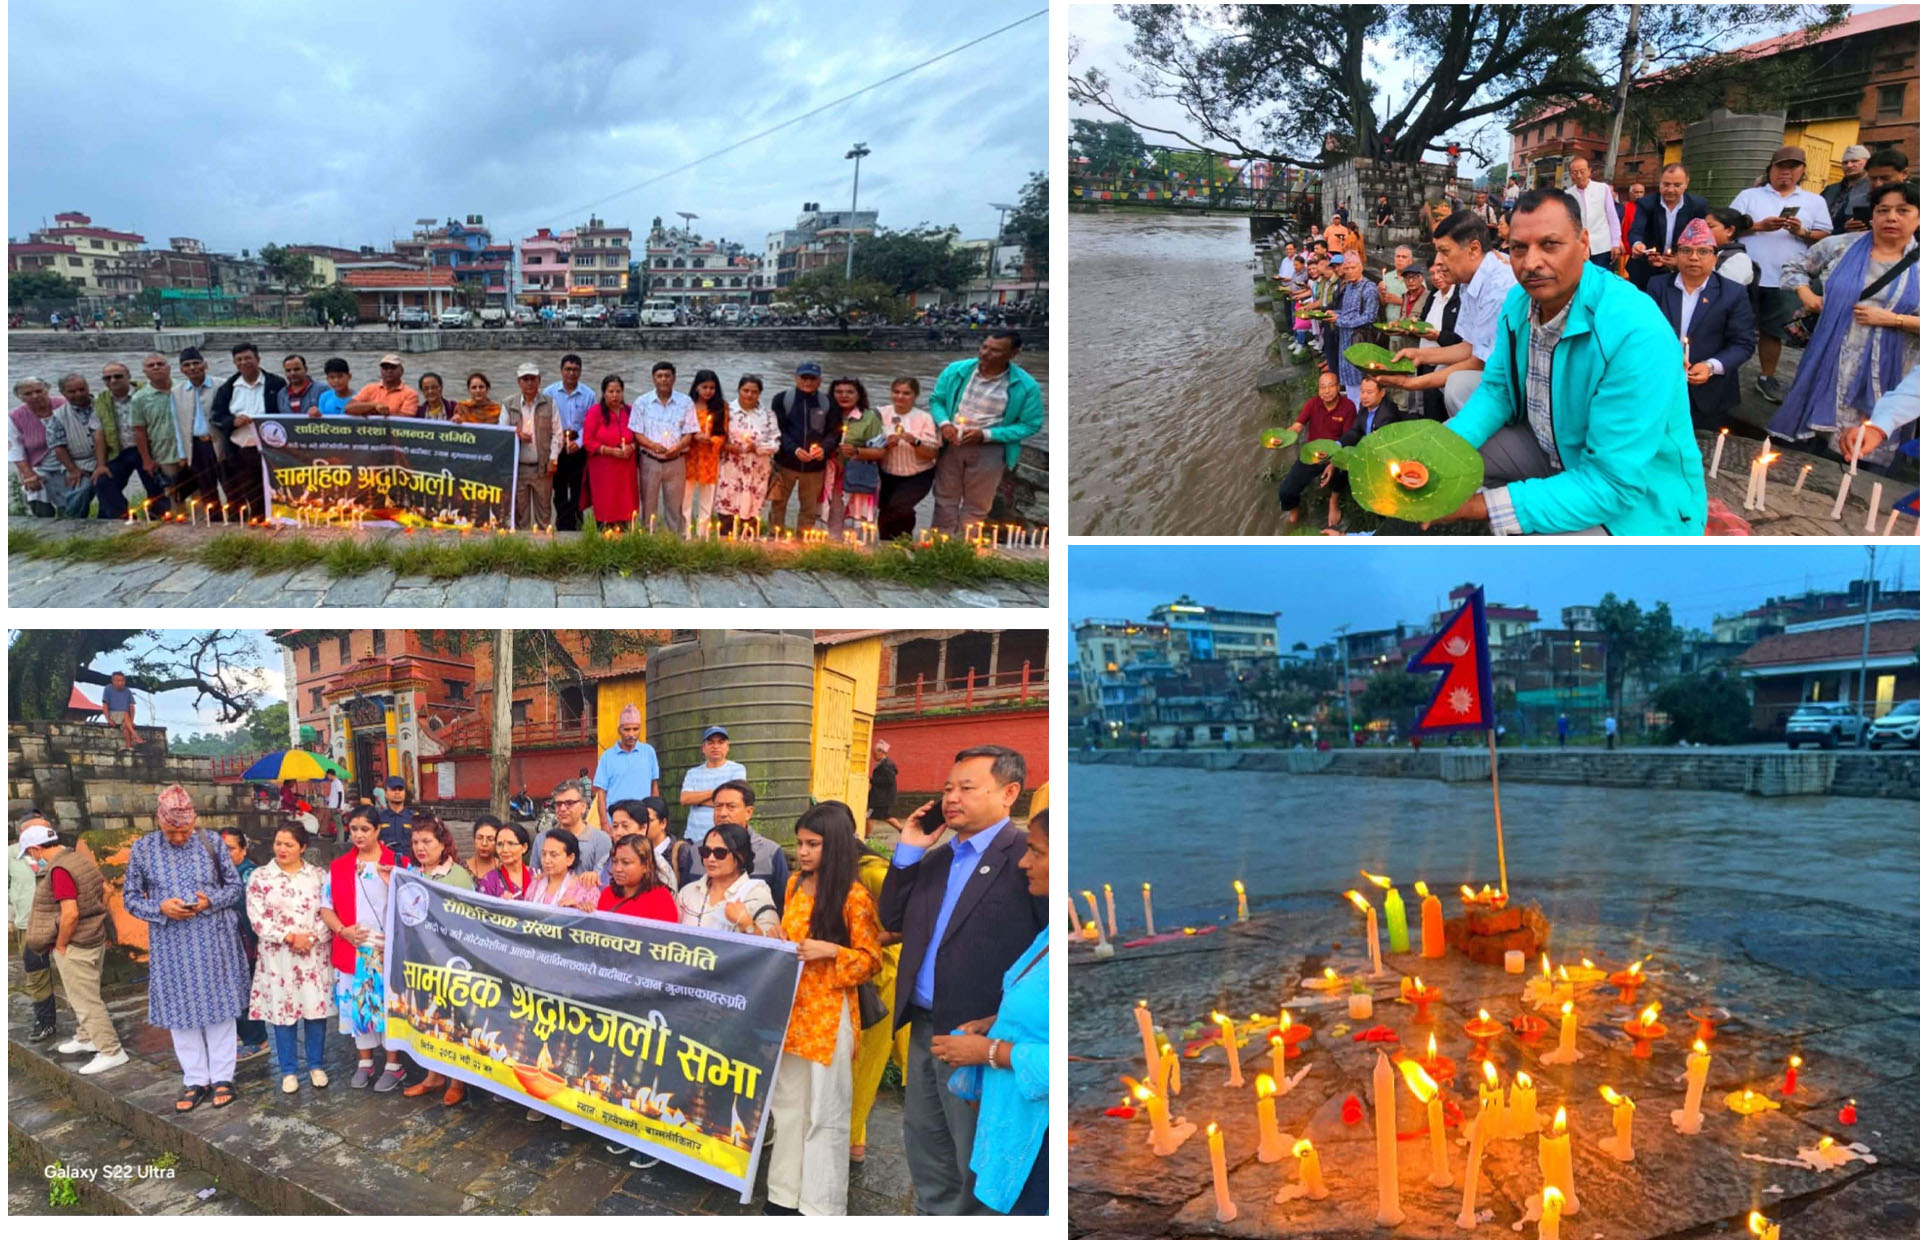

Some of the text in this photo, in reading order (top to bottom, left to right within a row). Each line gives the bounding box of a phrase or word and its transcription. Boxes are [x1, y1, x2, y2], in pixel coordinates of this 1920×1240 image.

[439, 430, 476, 444] समिति
[273, 458, 503, 504] सामूहिक श्रद्धाञ्जली सभा
[442, 898, 520, 929] साहित्यिक
[522, 919, 565, 940] संस्था
[568, 928, 643, 956] समन्वय
[648, 941, 718, 971] समिति
[634, 975, 662, 992] ज्यान
[403, 956, 762, 1100] सामूहिक श्रद्धाञ्जली सभा
